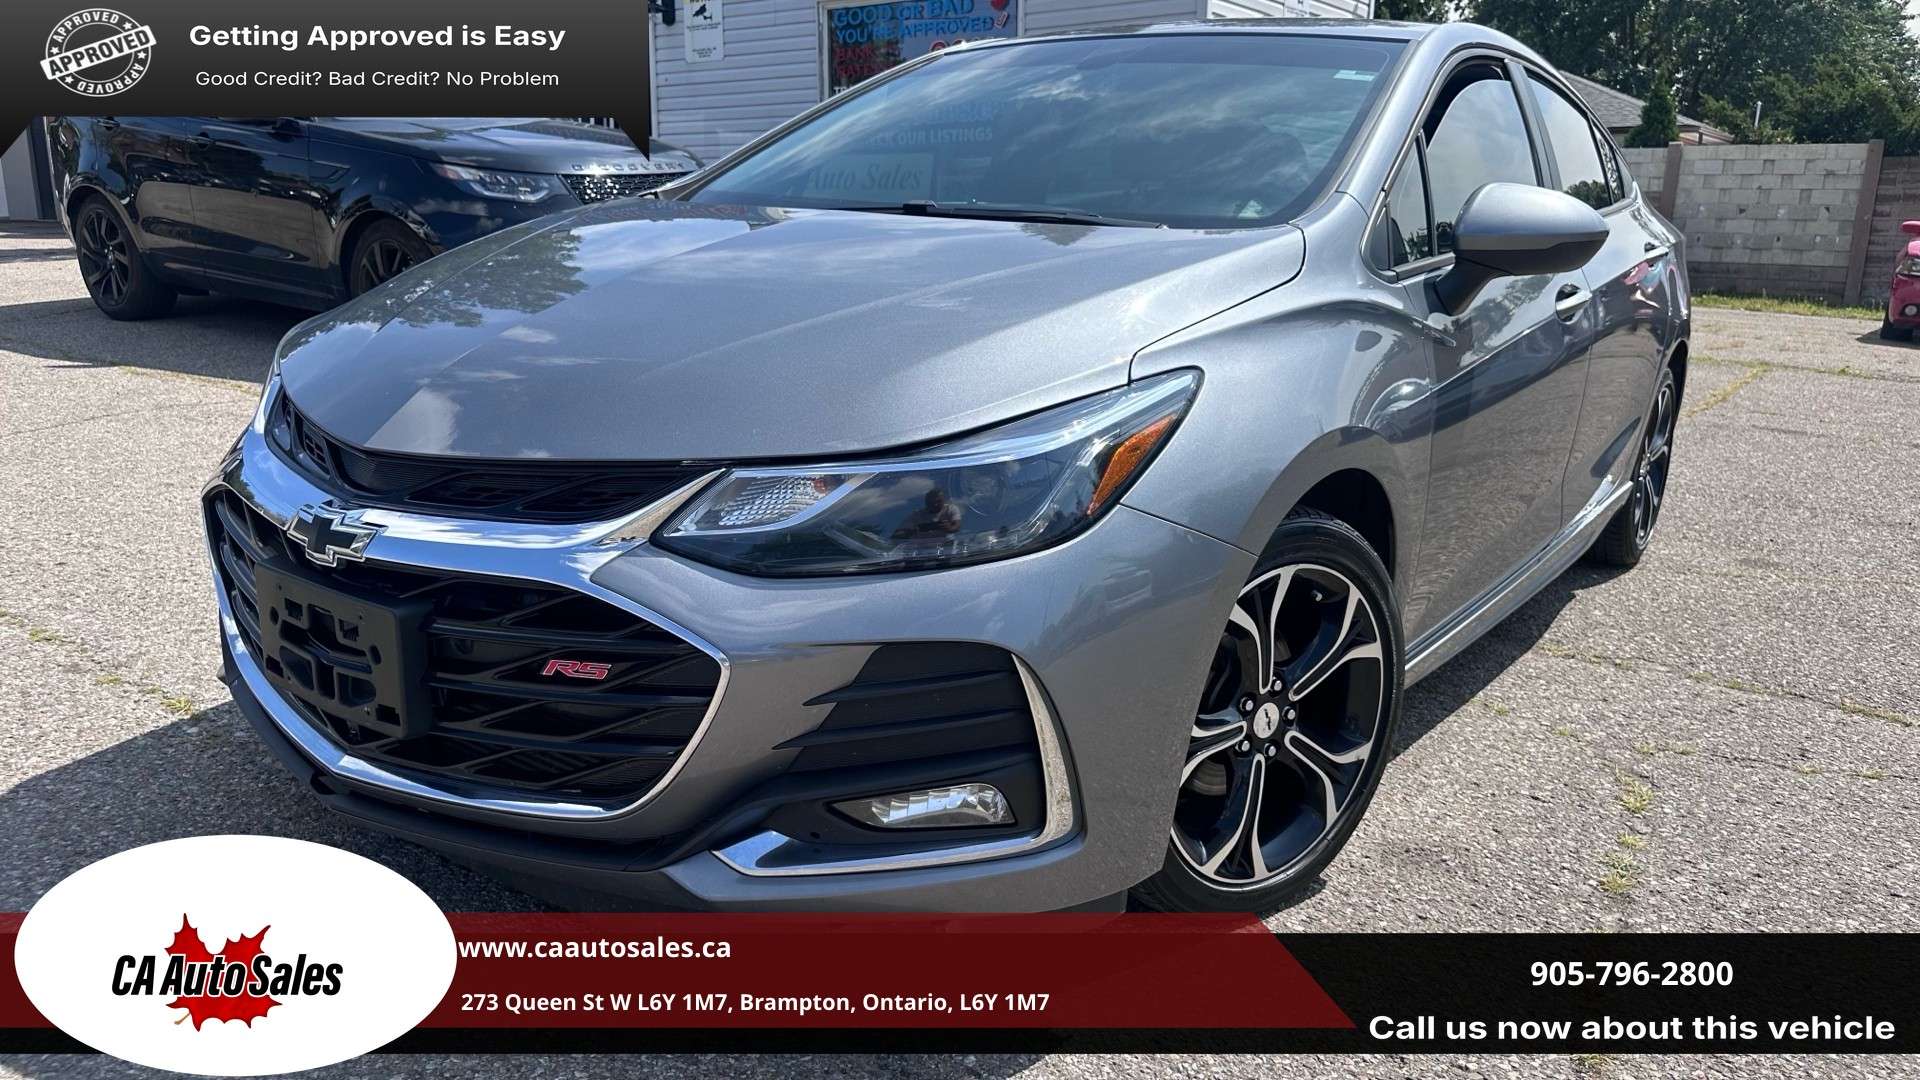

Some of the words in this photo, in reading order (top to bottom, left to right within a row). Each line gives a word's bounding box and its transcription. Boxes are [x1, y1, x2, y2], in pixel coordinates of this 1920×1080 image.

[834, 5, 893, 27] GOOD
[899, 4, 926, 21] OR
[928, 0, 975, 20] BAD
[900, 16, 993, 38] APPROVED
[930, 126, 993, 145] LISTINGS
[863, 159, 922, 190] Sales
[543, 659, 612, 680] RS
